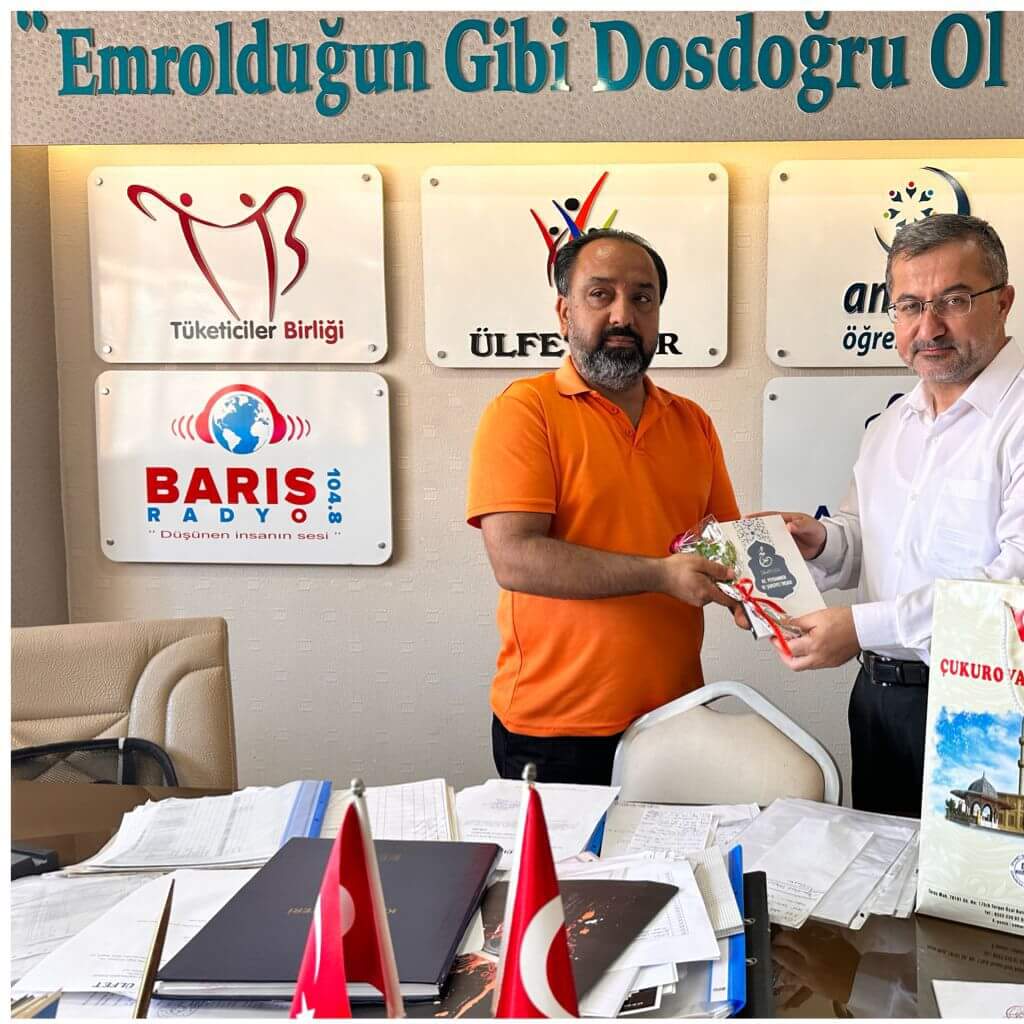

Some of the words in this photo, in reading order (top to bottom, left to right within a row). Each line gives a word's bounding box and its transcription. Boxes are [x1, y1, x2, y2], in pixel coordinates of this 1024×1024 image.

[445, 16, 571, 93] Gibi
[590, 12, 911, 113] Dosdoğru
[930, 12, 1008, 90] Ol
[170, 321, 277, 339] Tüketiciler
[284, 320, 344, 344] Birliği
[327, 468, 342, 523] 104.8
[147, 507, 307, 523] RADYO
[160, 530, 230, 541] Düşünen
[235, 530, 292, 540] insanın
[297, 531, 329, 540] sesi
